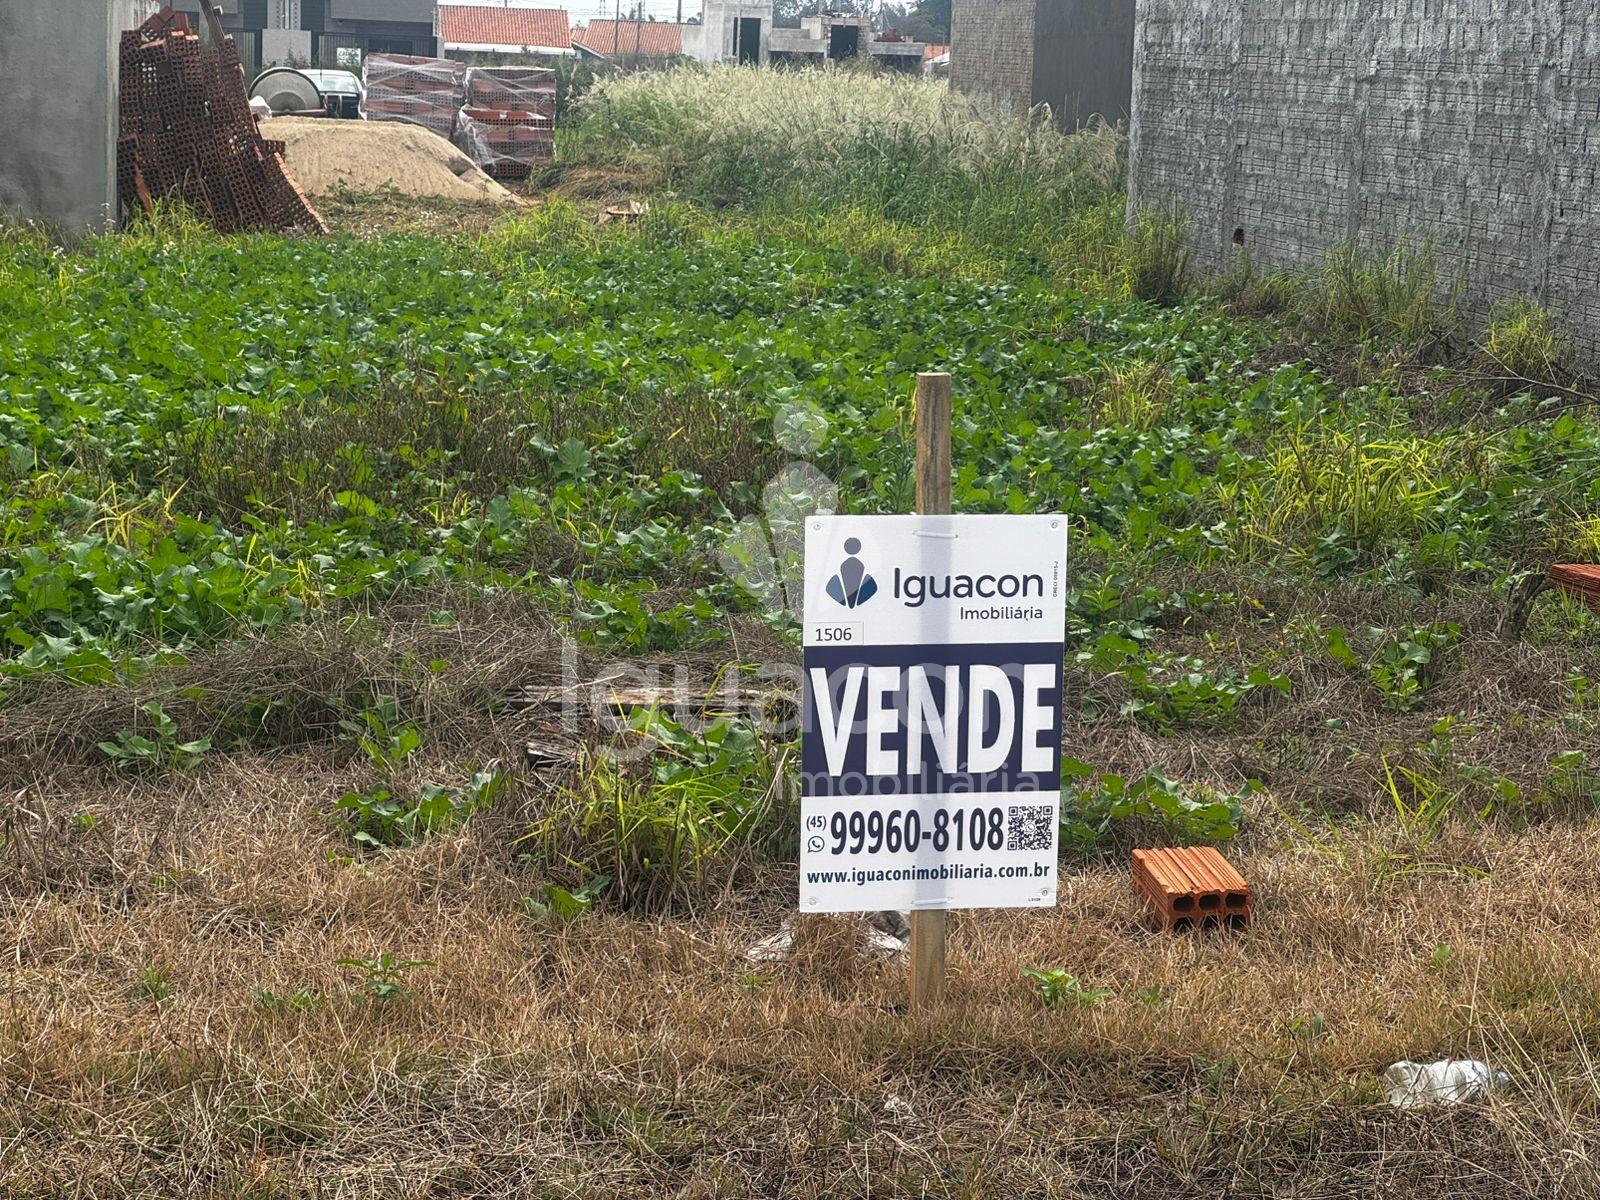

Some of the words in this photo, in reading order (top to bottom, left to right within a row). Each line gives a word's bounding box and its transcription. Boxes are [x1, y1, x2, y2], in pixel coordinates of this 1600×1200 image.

[893, 567, 1043, 608] Iguacon
[960, 606, 1043, 621] Imobiliária
[815, 627, 852, 642] 1506
[809, 663, 1057, 777] VENDE
[806, 815, 827, 832] (45)
[830, 807, 1004, 855] 99960-8108
[807, 862, 1050, 886] www.iguaconimobiliaria.com.br
